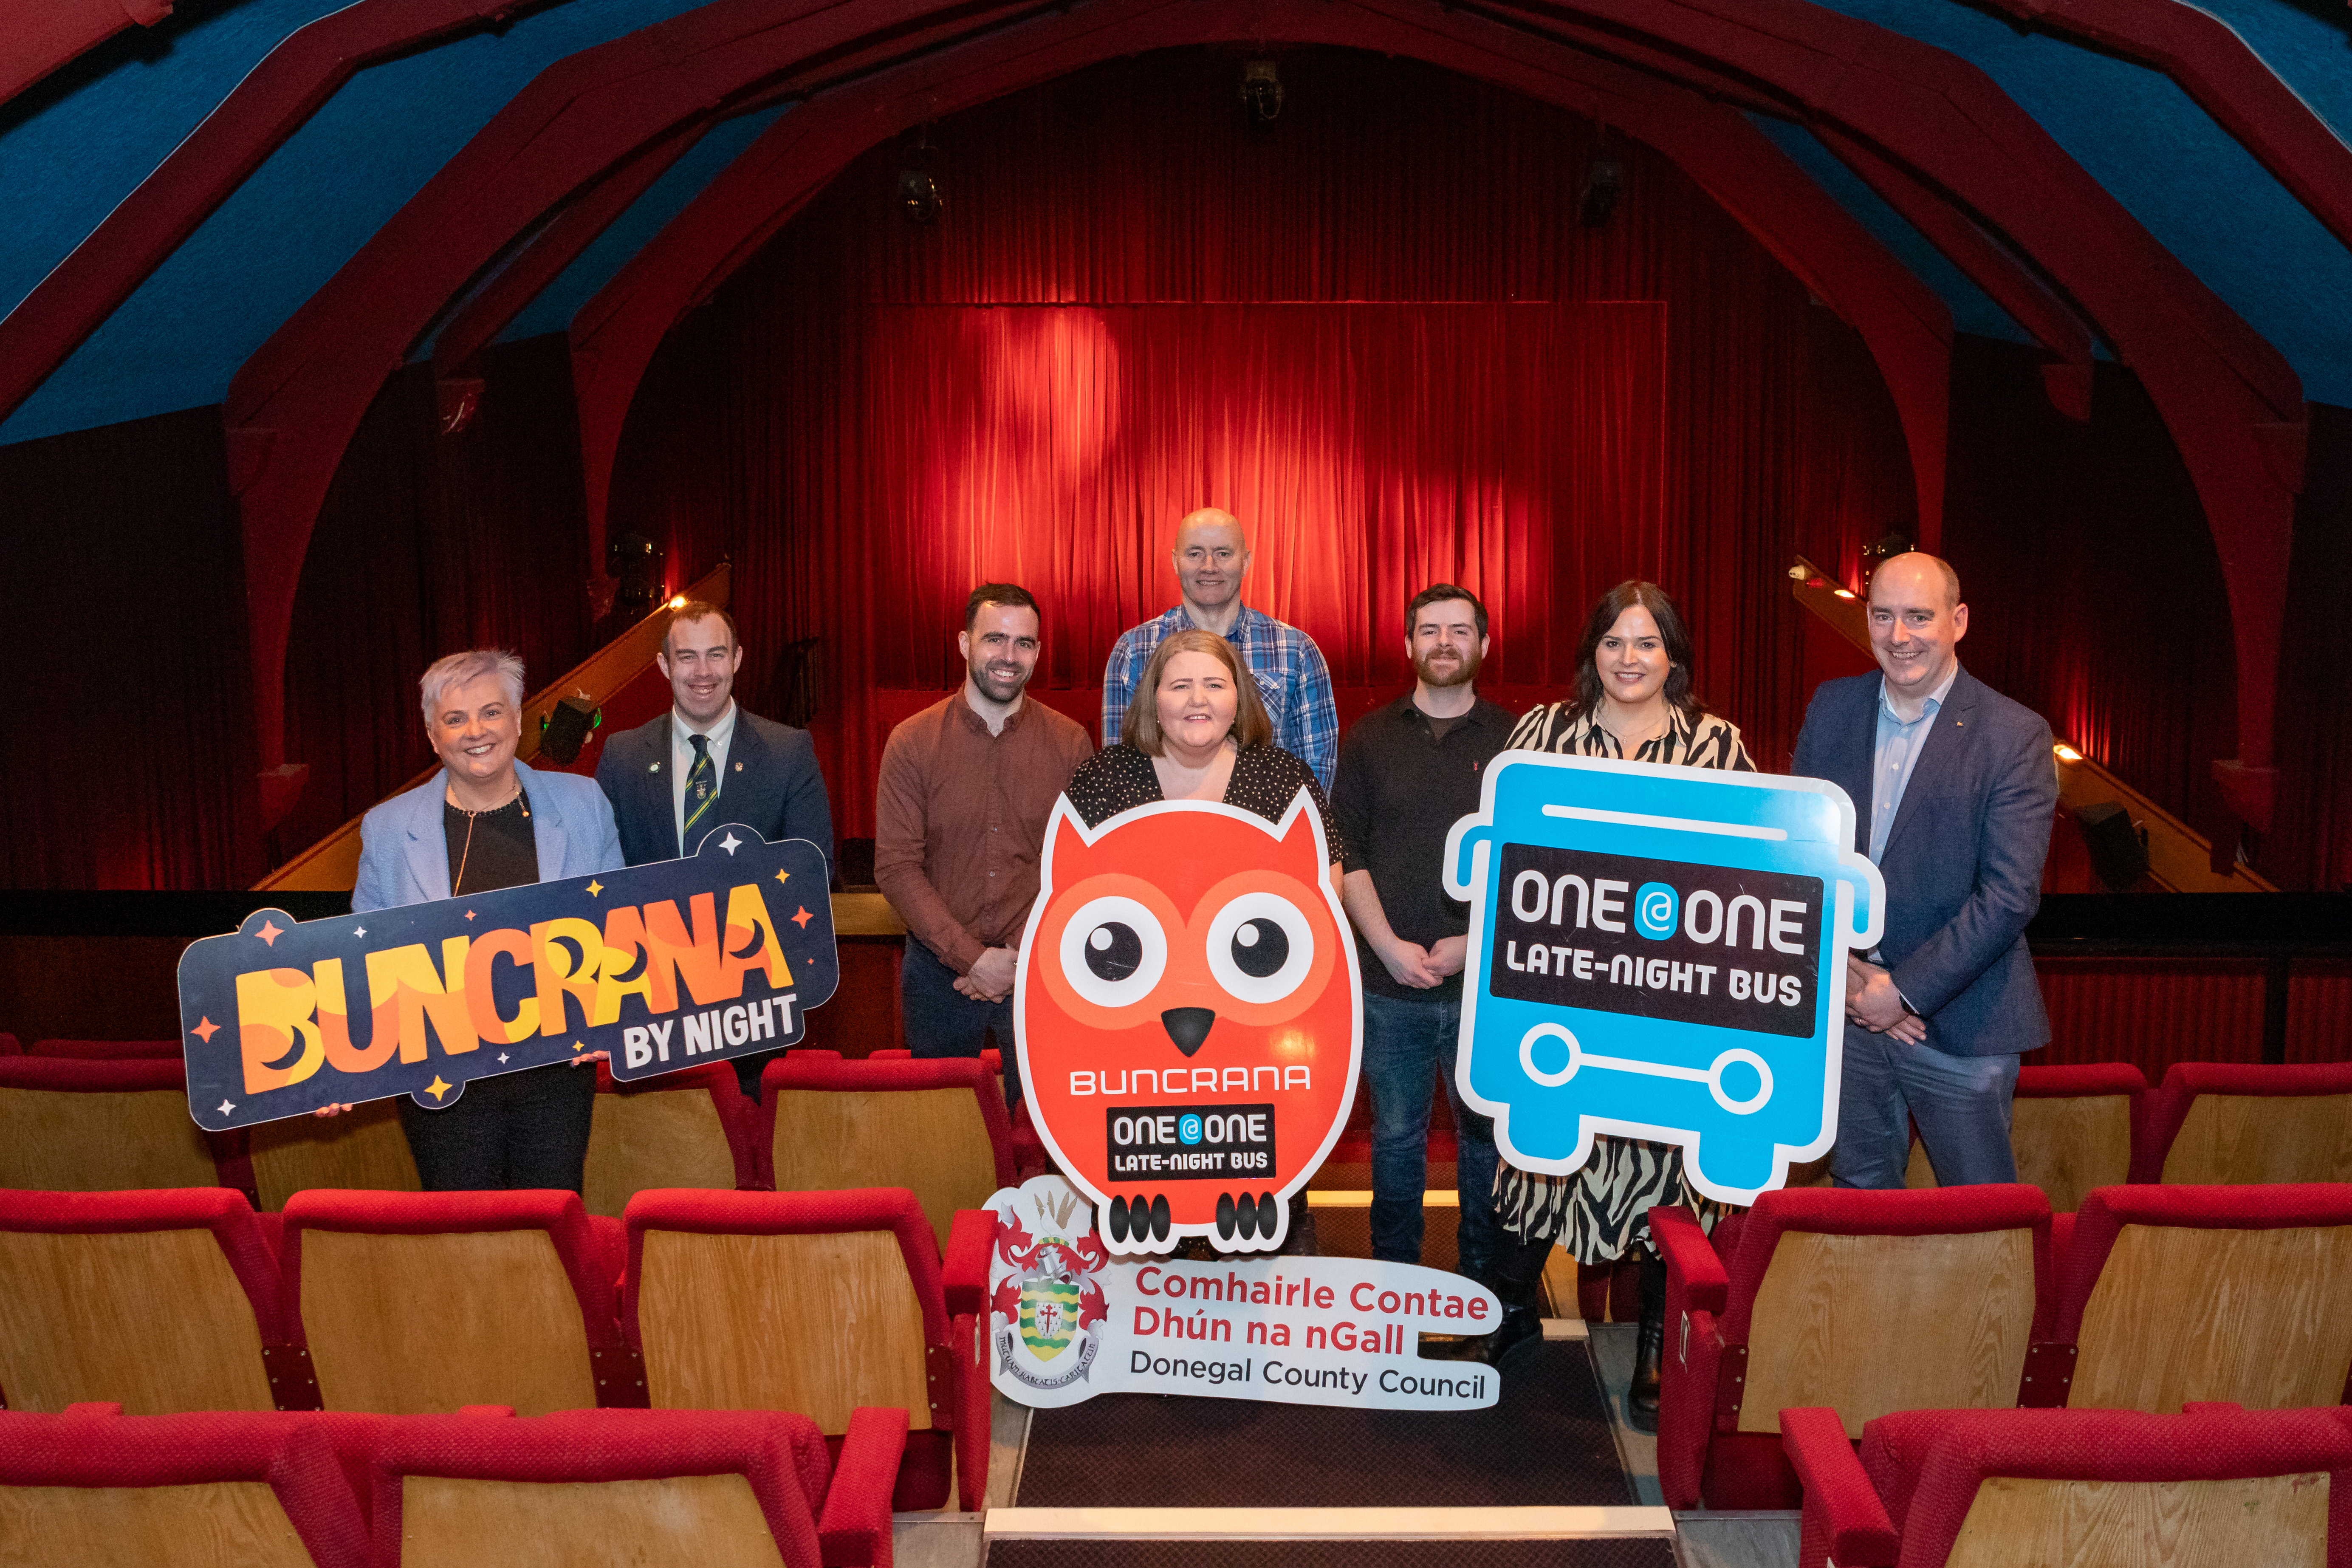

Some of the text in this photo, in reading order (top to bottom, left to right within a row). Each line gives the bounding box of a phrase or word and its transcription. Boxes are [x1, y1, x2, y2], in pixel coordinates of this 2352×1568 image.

[236, 884, 793, 1095] BUNCRANA
[1506, 940, 1801, 1006] LATE-NIGHT BUS
[624, 993, 797, 1069] BY NIGHT
[1070, 1065, 1310, 1096] BUNCRANA
[1115, 1152, 1268, 1171] LATE-NIGHT BUS
[1135, 1266, 1488, 1319] Comhairle Contae
[1133, 1305, 1403, 1355] Dhún na nGall
[1131, 1350, 1485, 1399] Donegal County Council
